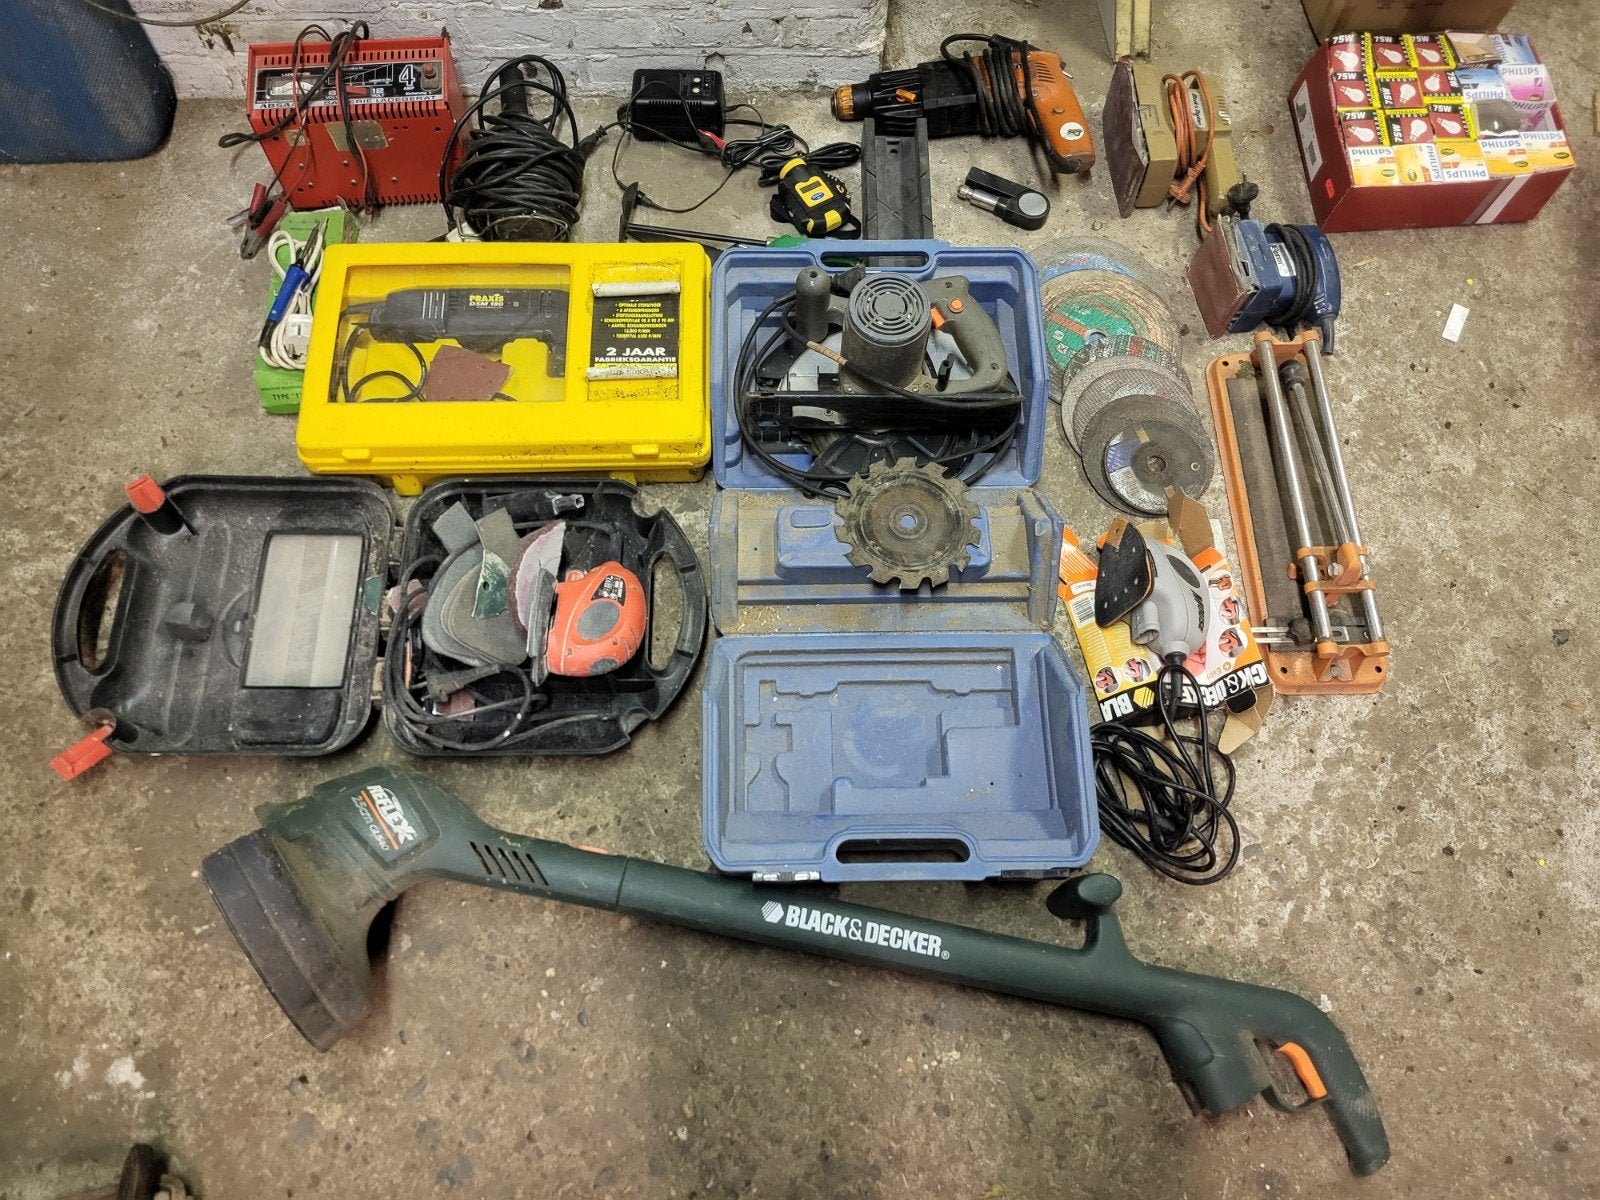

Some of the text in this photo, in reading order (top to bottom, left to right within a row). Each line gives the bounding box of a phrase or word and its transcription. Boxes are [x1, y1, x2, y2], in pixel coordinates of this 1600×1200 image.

[1332, 34, 1354, 45] 75W
[1374, 35, 1393, 43] 75W
[1411, 35, 1430, 43] 75W
[398, 64, 416, 88] 4
[1336, 72, 1357, 80] 75W
[1501, 67, 1540, 76] PHILIPS
[1447, 72, 1459, 88] 75W
[1382, 87, 1394, 105] 75W
[1465, 90, 1504, 100] PHILIPS
[1432, 104, 1452, 113] 75W
[1512, 101, 1549, 110] PHILIPS
[1344, 111, 1366, 120] 75W
[1393, 123, 1404, 143] 75W
[1523, 132, 1564, 141] PHILIPS
[1481, 139, 1522, 148] PHILIPS
[1351, 147, 1392, 156] PHILIPS
[1426, 145, 1442, 179] PHILIPS
[1446, 169, 1487, 178] PHILIPS
[468, 293, 505, 302] PRAXIS
[606, 347, 666, 356] 2 JAAR
[366, 784, 418, 845] REFLEX
